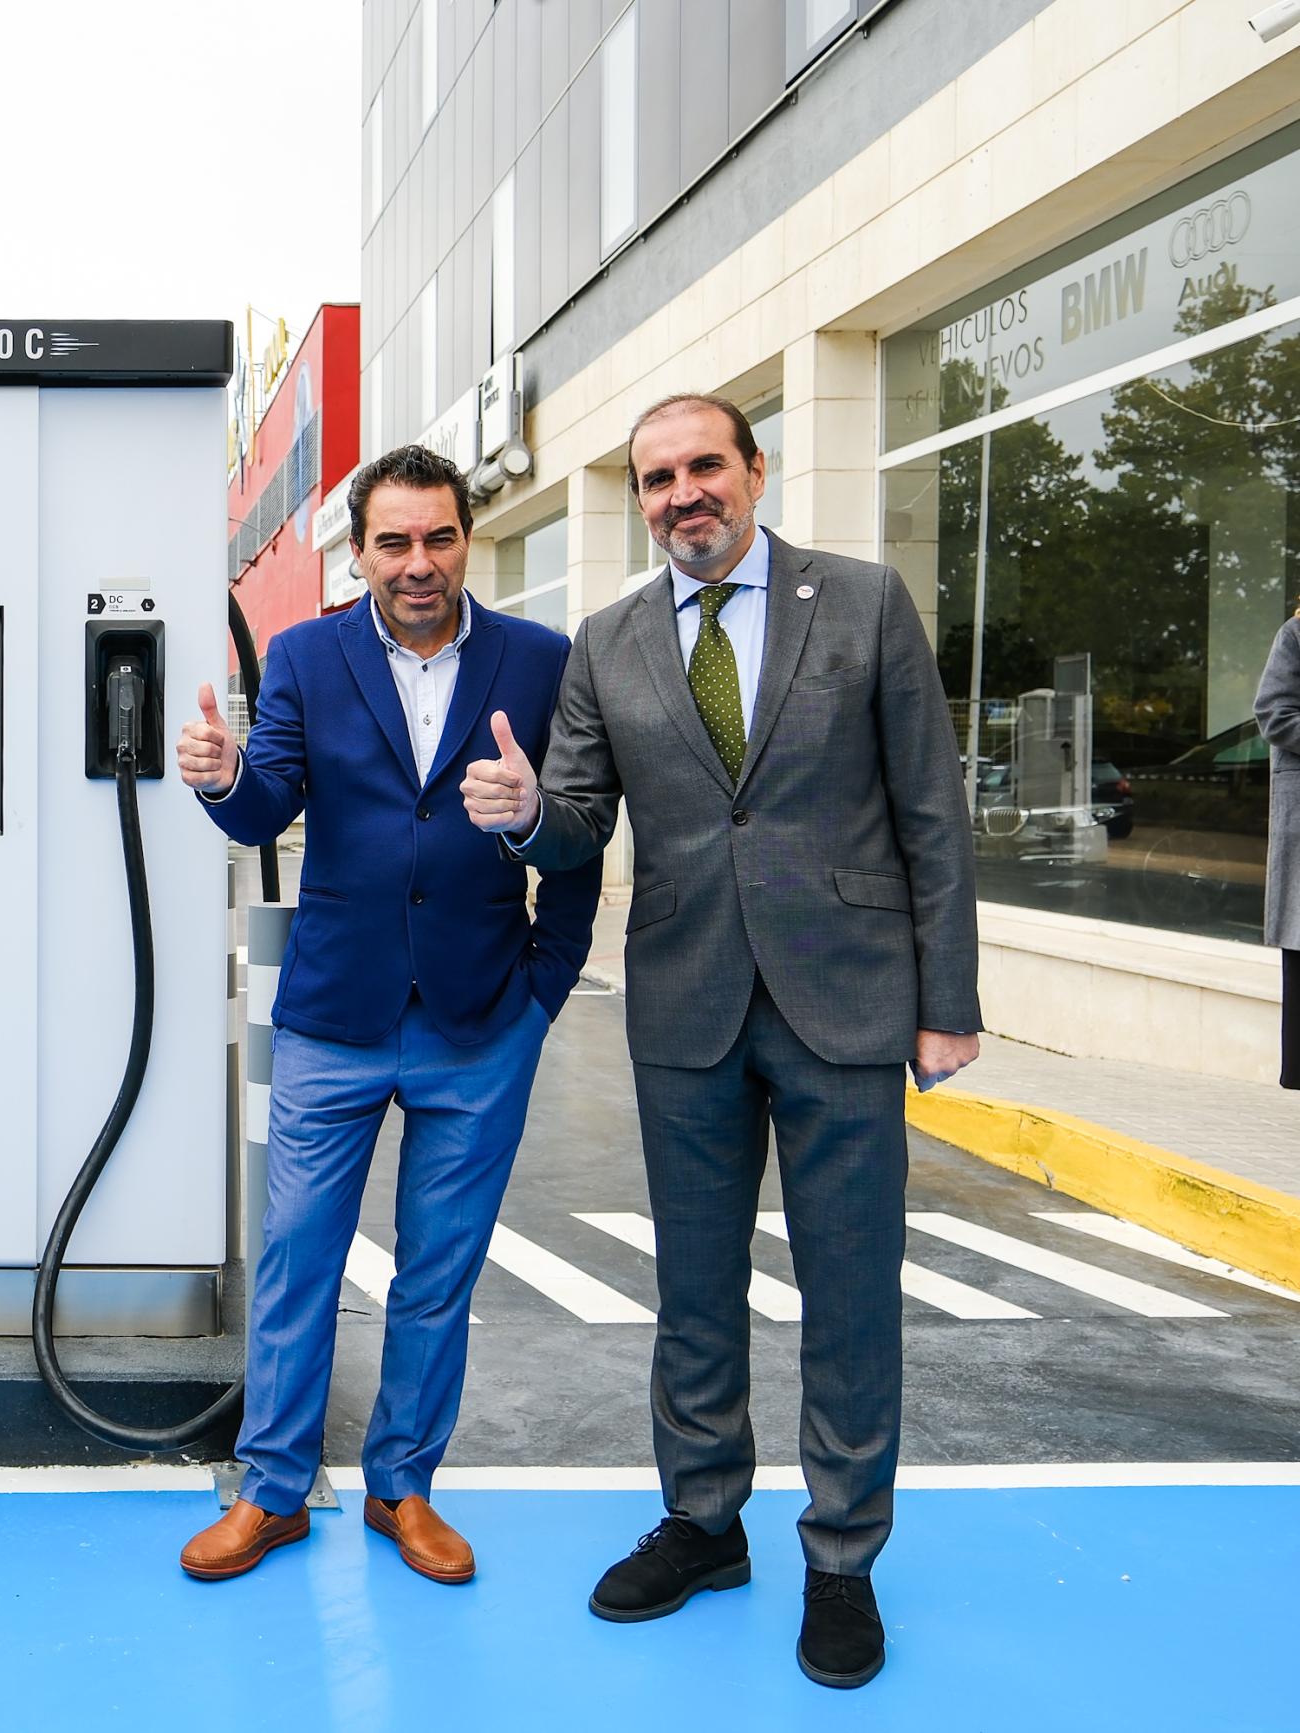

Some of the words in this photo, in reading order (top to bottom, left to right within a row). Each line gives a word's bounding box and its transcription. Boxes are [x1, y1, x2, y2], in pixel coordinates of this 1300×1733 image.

[1060, 246, 1149, 345] BMW
[1177, 261, 1239, 307] Audi
[24, 328, 44, 360] C
[918, 289, 1028, 367] VEHICULOS
[958, 336, 1045, 405] NUEVOS
[90, 598, 99, 610] 2
[109, 595, 124, 604] DC
